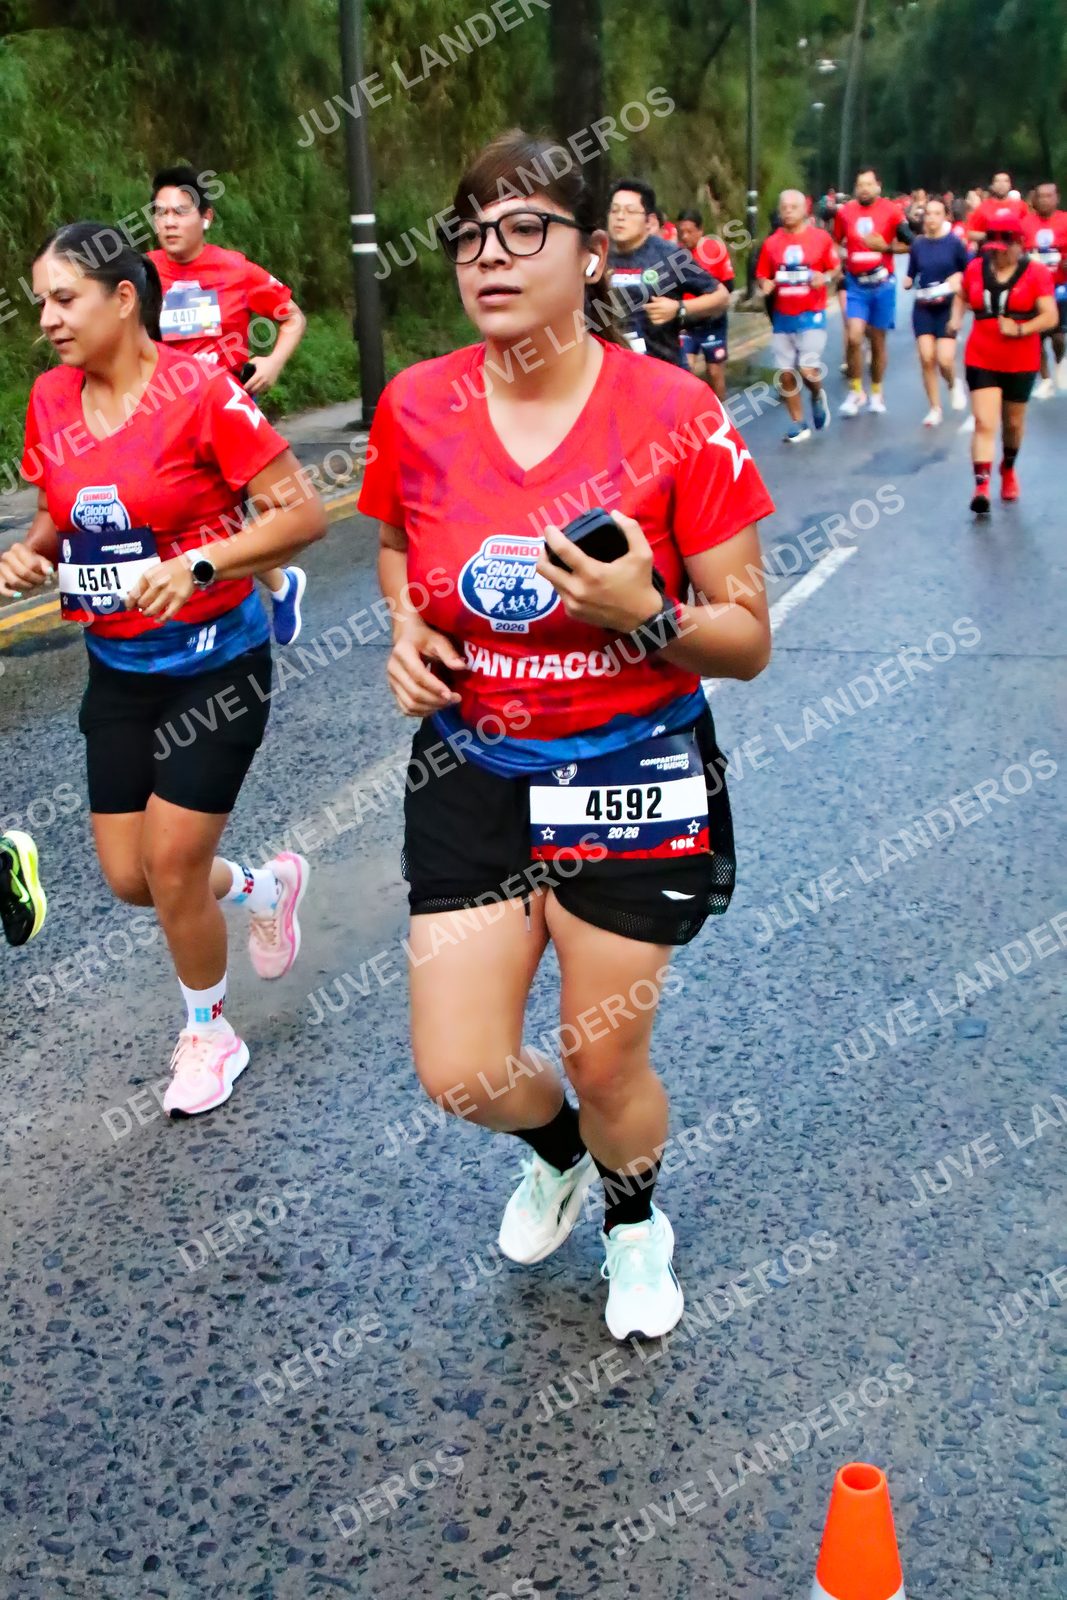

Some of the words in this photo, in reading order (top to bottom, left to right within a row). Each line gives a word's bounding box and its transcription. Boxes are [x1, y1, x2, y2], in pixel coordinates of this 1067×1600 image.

[172, 309, 197, 323] 4417
[84, 504, 113, 516] Global
[81, 514, 104, 525] Race
[490, 544, 540, 556] BIMBO
[486, 560, 536, 578] Global
[79, 566, 121, 591] 4541
[474, 573, 516, 590] Race
[495, 622, 525, 632] 2026
[464, 640, 610, 681] SANTIAGO
[586, 786, 662, 821] 4592
[607, 827, 640, 839] 20-26
[670, 837, 694, 850] 10K
